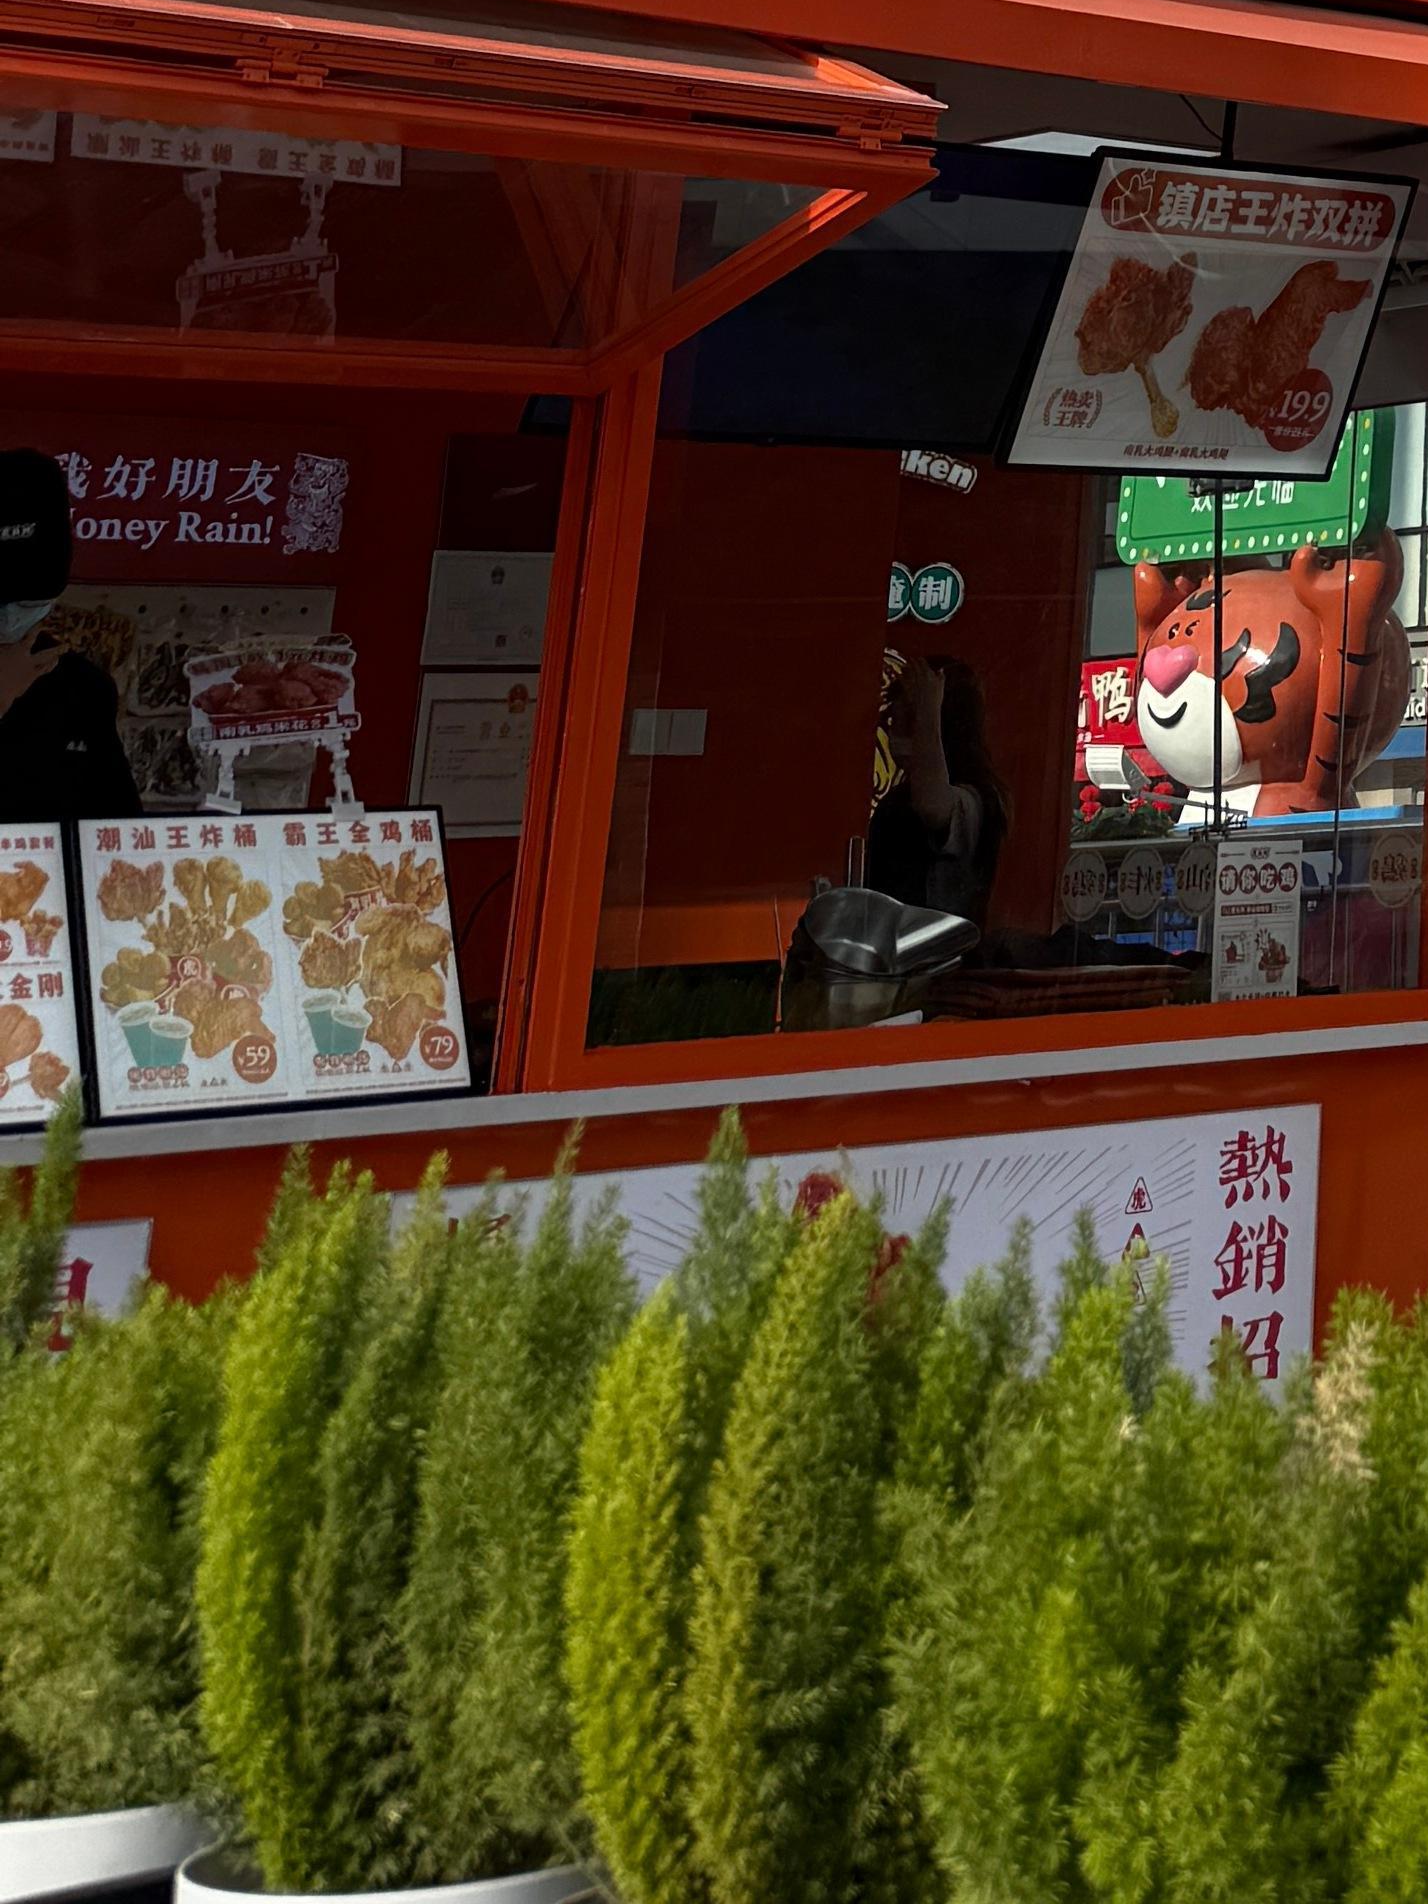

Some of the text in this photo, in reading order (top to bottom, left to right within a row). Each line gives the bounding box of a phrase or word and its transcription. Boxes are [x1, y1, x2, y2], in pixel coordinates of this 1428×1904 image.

[1155, 180, 1385, 248] 镇店王炸双拼
[70, 507, 169, 550] oney
[175, 512, 273, 545] Rain!
[95, 817, 435, 852] 潮汕王炸桶 霸王全鸡桶
[0, 971, 64, 1001] 金刚
